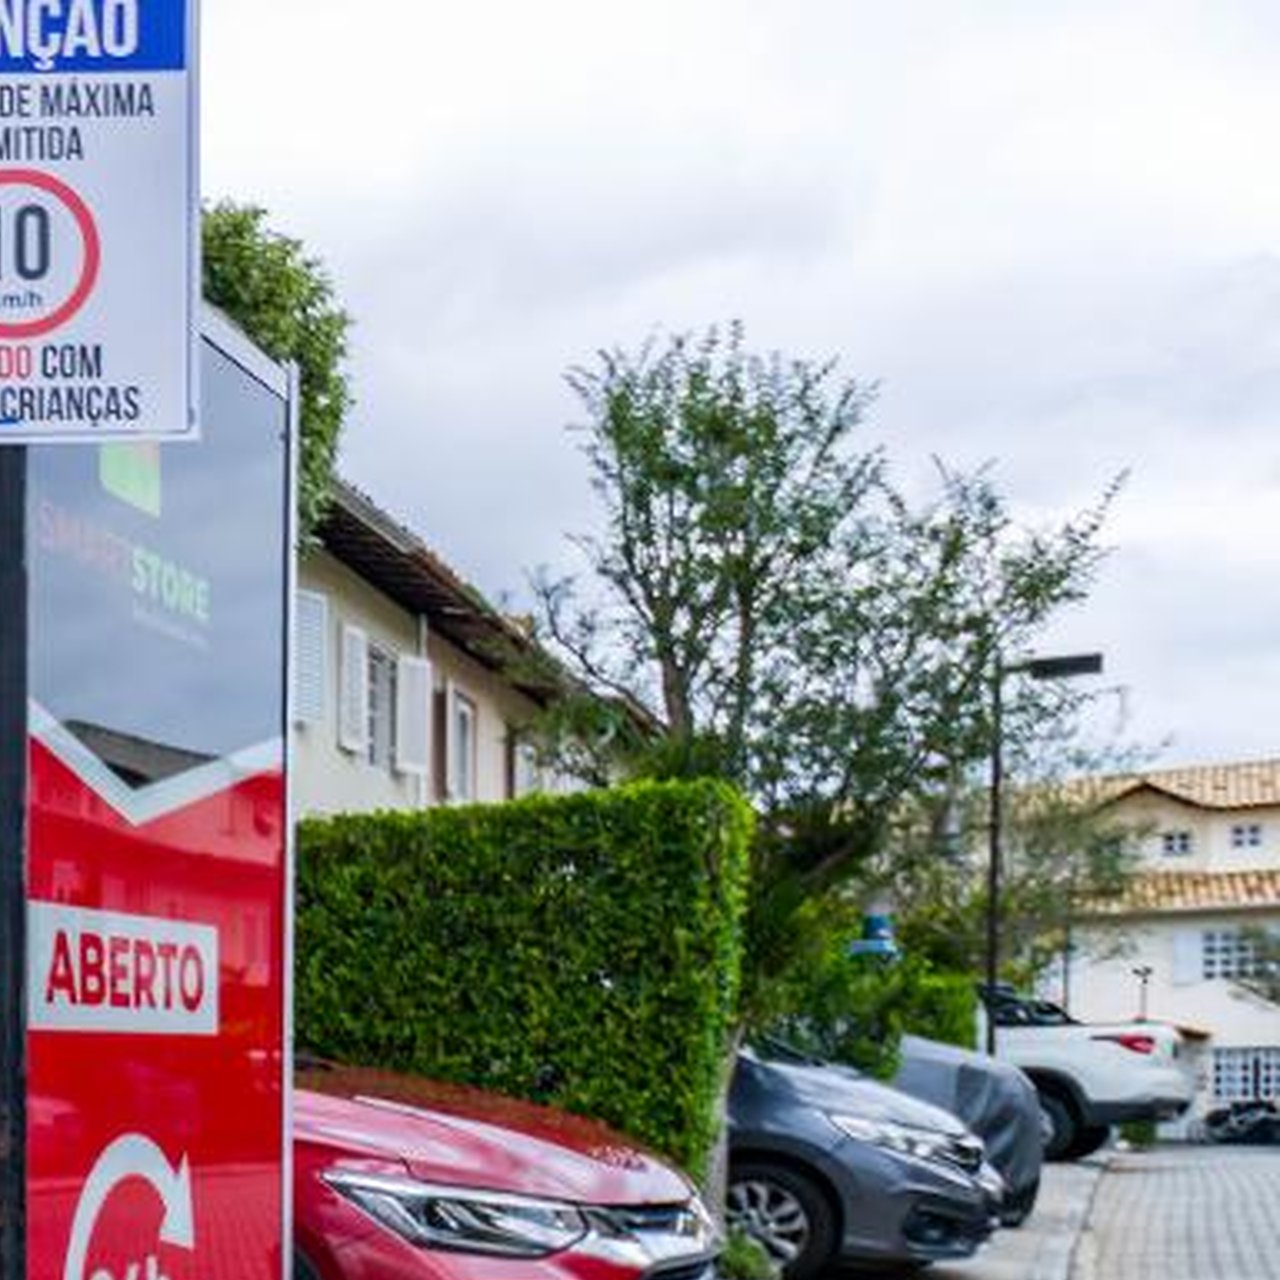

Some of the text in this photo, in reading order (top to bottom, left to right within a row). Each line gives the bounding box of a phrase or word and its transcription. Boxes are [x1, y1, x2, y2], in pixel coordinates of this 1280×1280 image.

[40, 77, 155, 118] MÁXIMA
[40, 344, 102, 379] COM
[0, 385, 140, 428] CRIANÇAS
[45, 929, 205, 1013] ABERTO
